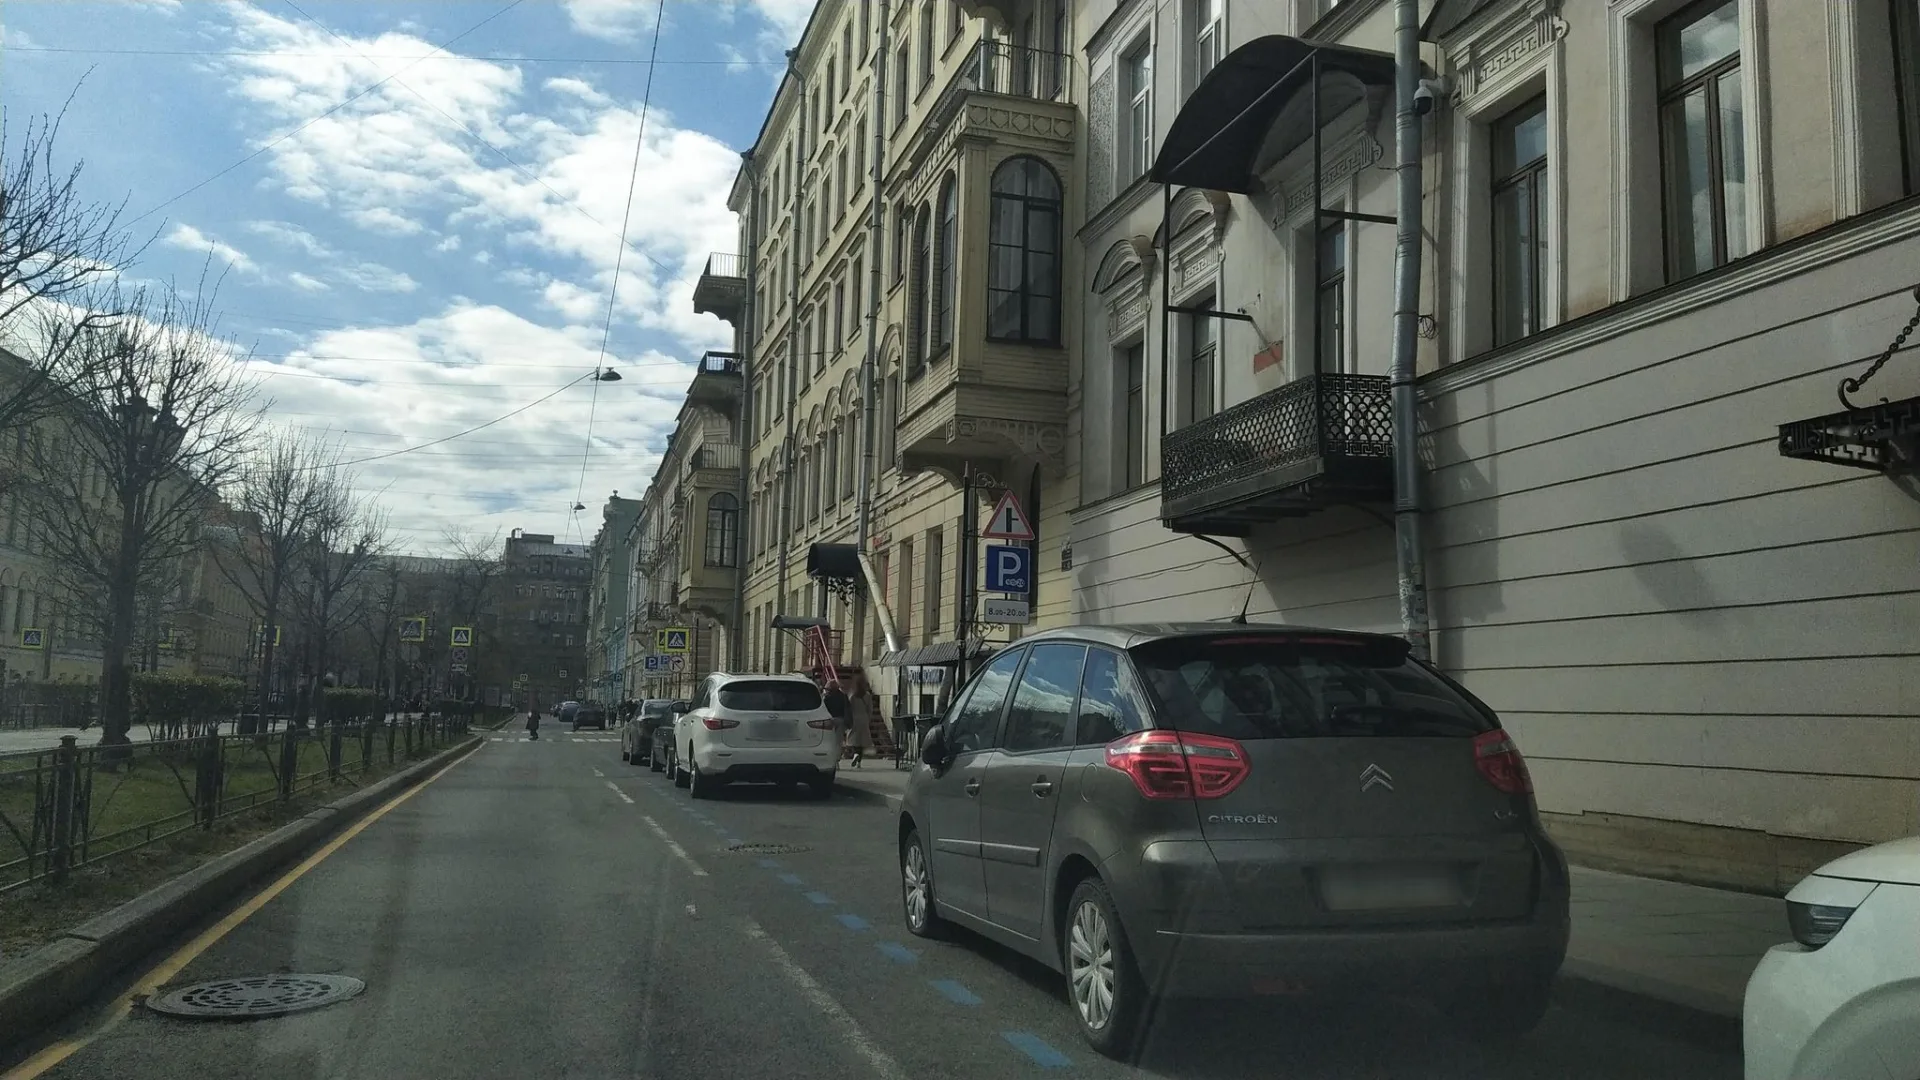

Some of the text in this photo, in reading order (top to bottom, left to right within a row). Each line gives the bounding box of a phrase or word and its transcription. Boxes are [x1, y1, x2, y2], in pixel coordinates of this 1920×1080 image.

[998, 551, 1021, 586] P
[988, 608, 1027, 617] 8.00-20.00
[1208, 814, 1278, 824] CITROËN
